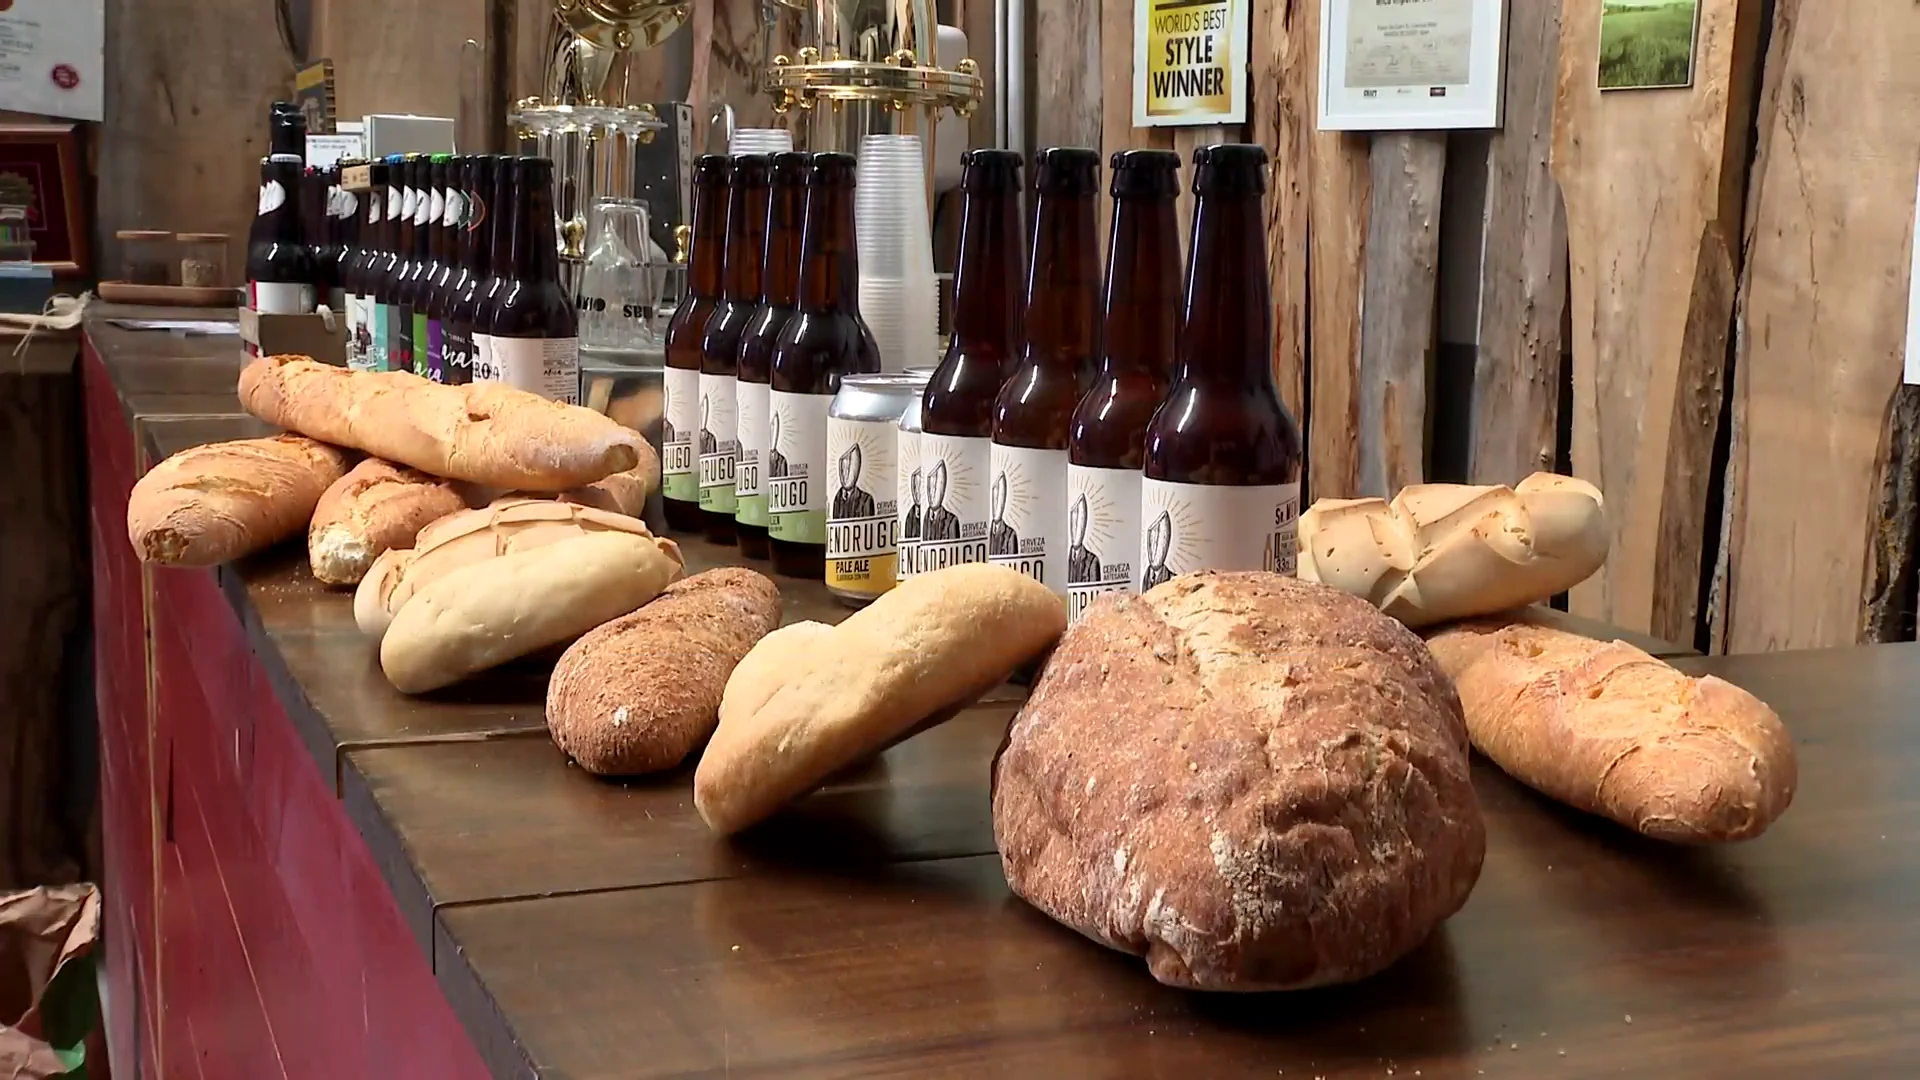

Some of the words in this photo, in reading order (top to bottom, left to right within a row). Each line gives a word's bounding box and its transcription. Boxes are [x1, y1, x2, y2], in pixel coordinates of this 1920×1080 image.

[1154, 12, 1200, 34] WORLD'S
[1203, 9, 1227, 30] BEST
[1165, 35, 1213, 66] STYLE
[1153, 67, 1224, 98] WINNER
[961, 520, 988, 532] CERVEZA
[1020, 537, 1046, 547] CERVEZA
[836, 561, 853, 574] PALE
[854, 560, 870, 573] ALE
[1103, 562, 1131, 574] CERVEZA
